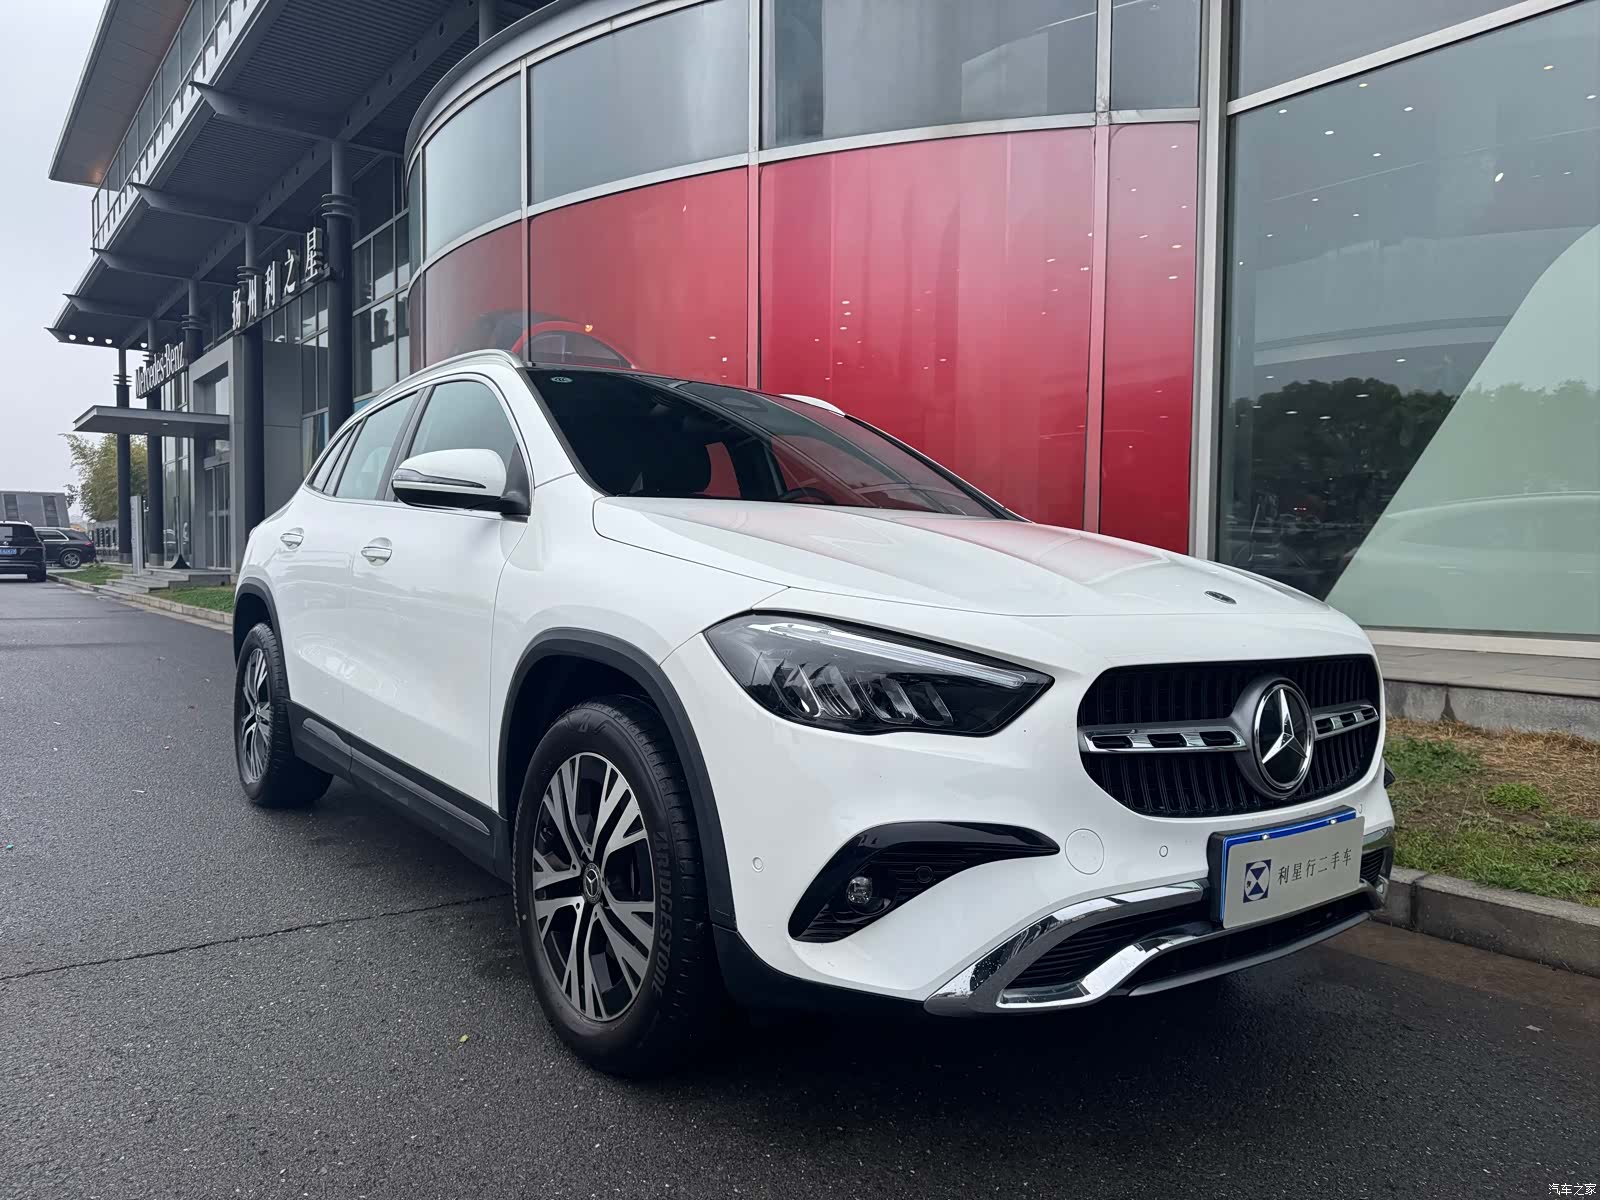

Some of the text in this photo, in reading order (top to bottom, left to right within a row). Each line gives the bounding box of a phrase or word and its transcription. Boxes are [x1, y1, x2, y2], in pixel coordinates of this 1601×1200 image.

[231, 226, 319, 331] 扬州利之星
[136, 341, 185, 397] Mercedes-Benz
[1277, 848, 1352, 886] 利星行二手车
